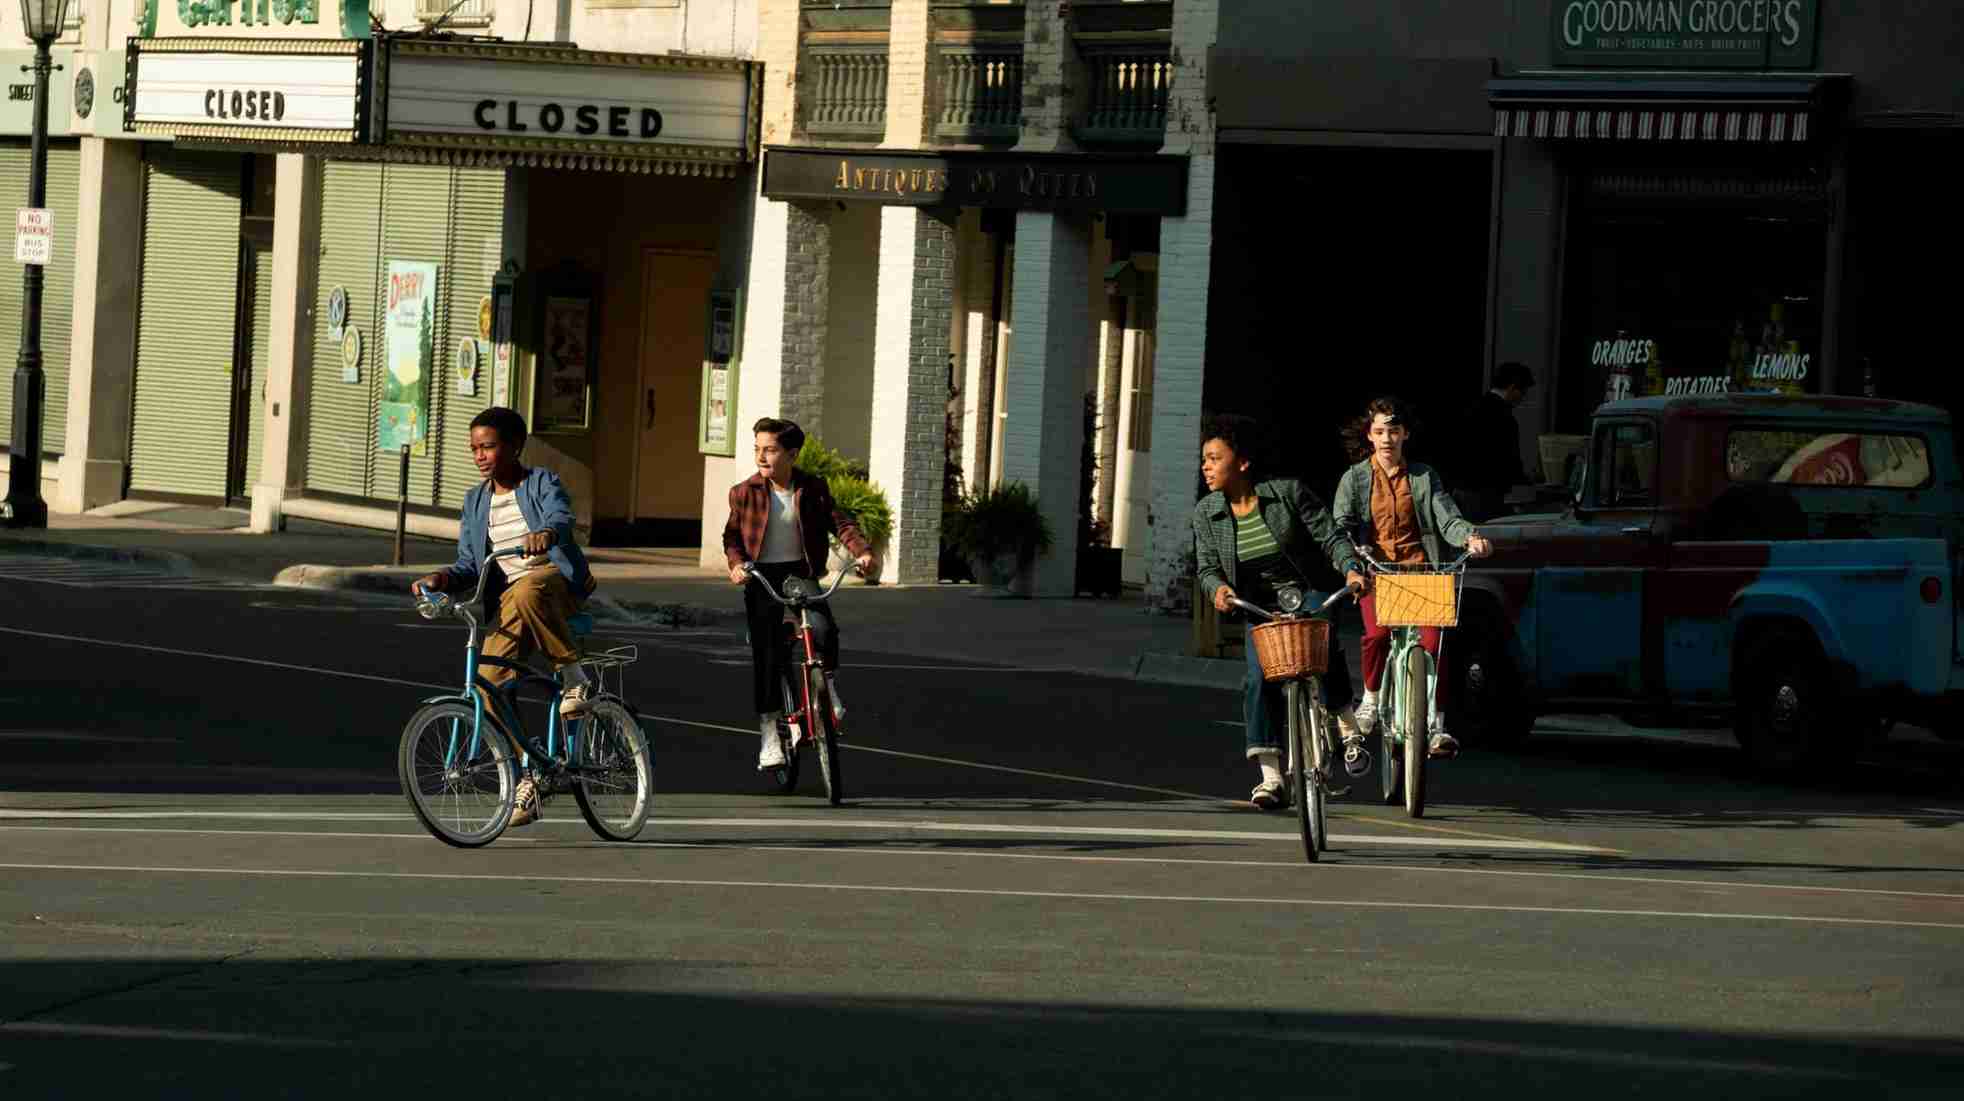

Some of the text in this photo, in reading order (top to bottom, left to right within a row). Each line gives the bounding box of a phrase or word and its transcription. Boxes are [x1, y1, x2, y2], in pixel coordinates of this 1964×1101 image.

[1563, 0, 1801, 45] GOODMAN GROCERS
[204, 89, 285, 121] CLOSED
[473, 99, 663, 138] CLOSED
[834, 159, 952, 199] ANTIQUES
[1016, 160, 1097, 203] QUEEN
[18, 225, 49, 235] PARKING
[27, 214, 42, 224] NO
[22, 248, 45, 257] STOP
[24, 239, 43, 247] BUS
[390, 272, 424, 310] DERRY
[1591, 338, 1652, 366] ORANGES
[1751, 353, 1811, 381] LEMONS
[1665, 375, 1731, 396] POTATOES
